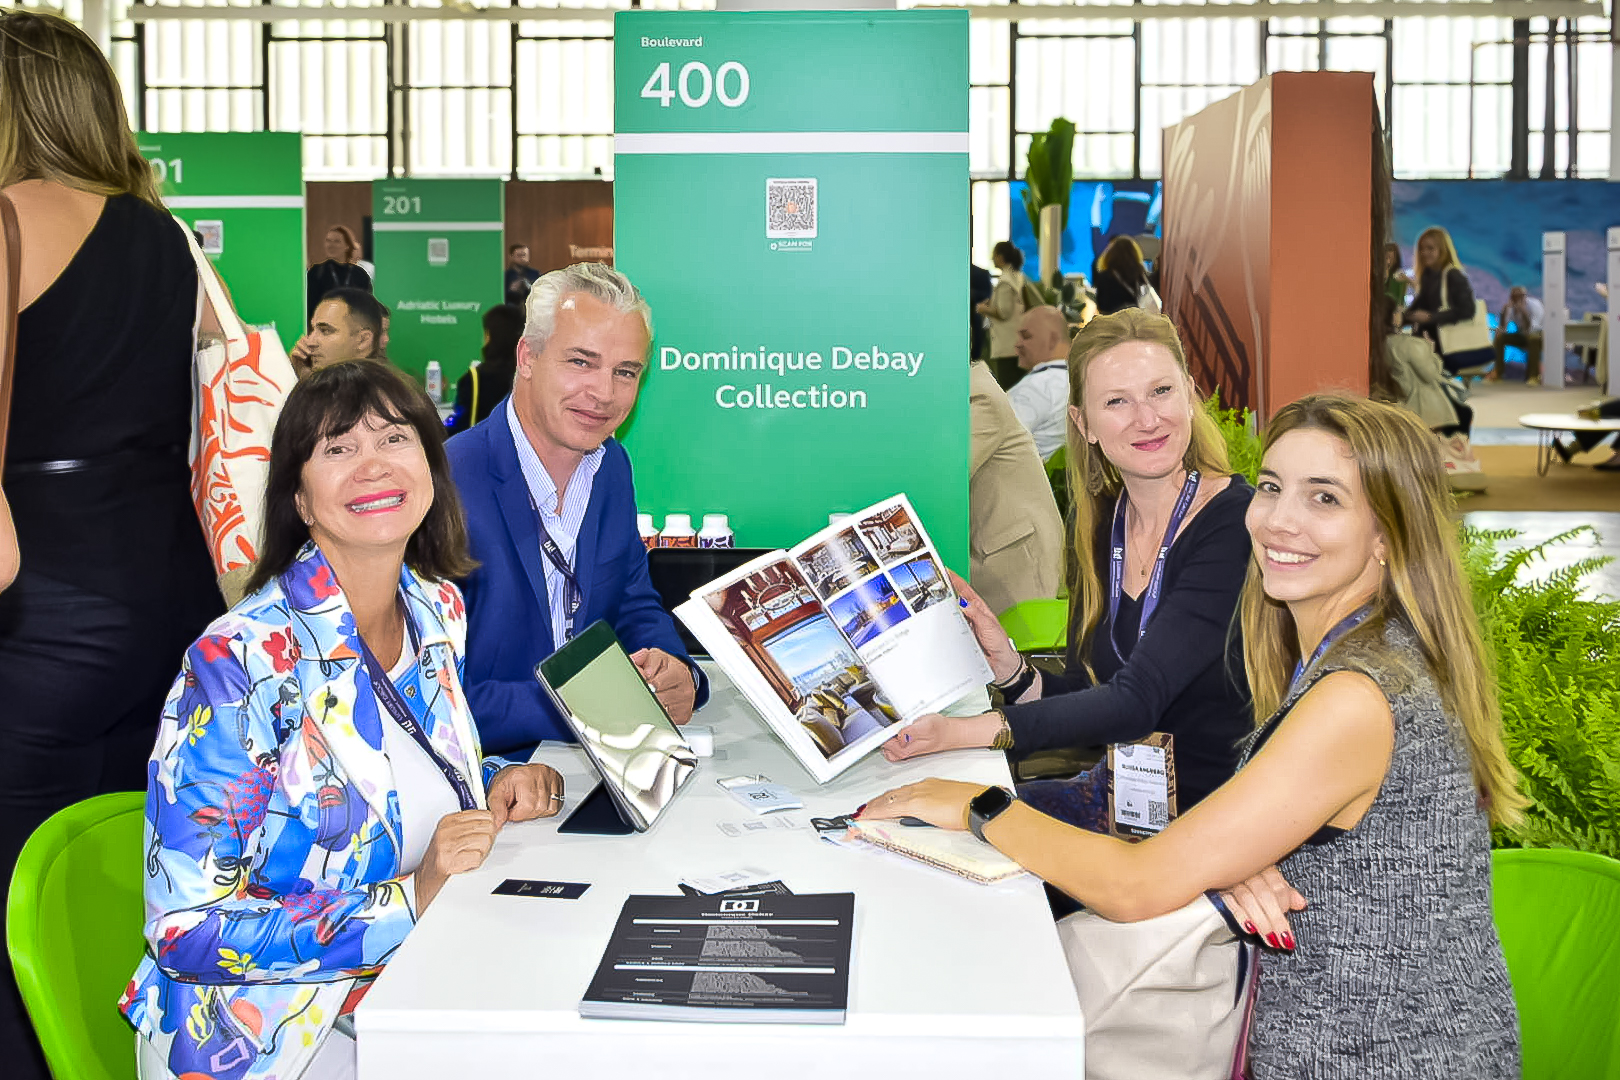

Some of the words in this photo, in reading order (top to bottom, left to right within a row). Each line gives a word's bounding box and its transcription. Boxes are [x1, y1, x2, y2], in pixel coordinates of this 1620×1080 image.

[641, 36, 703, 47] Boulevard
[640, 61, 750, 107] 400
[383, 196, 421, 215] 201
[396, 300, 440, 311] Adriatic
[441, 301, 481, 313] Luxury
[420, 314, 457, 324] Hotels
[660, 345, 823, 376] Dominique
[831, 345, 925, 377] Debay
[715, 383, 867, 409] Collection
